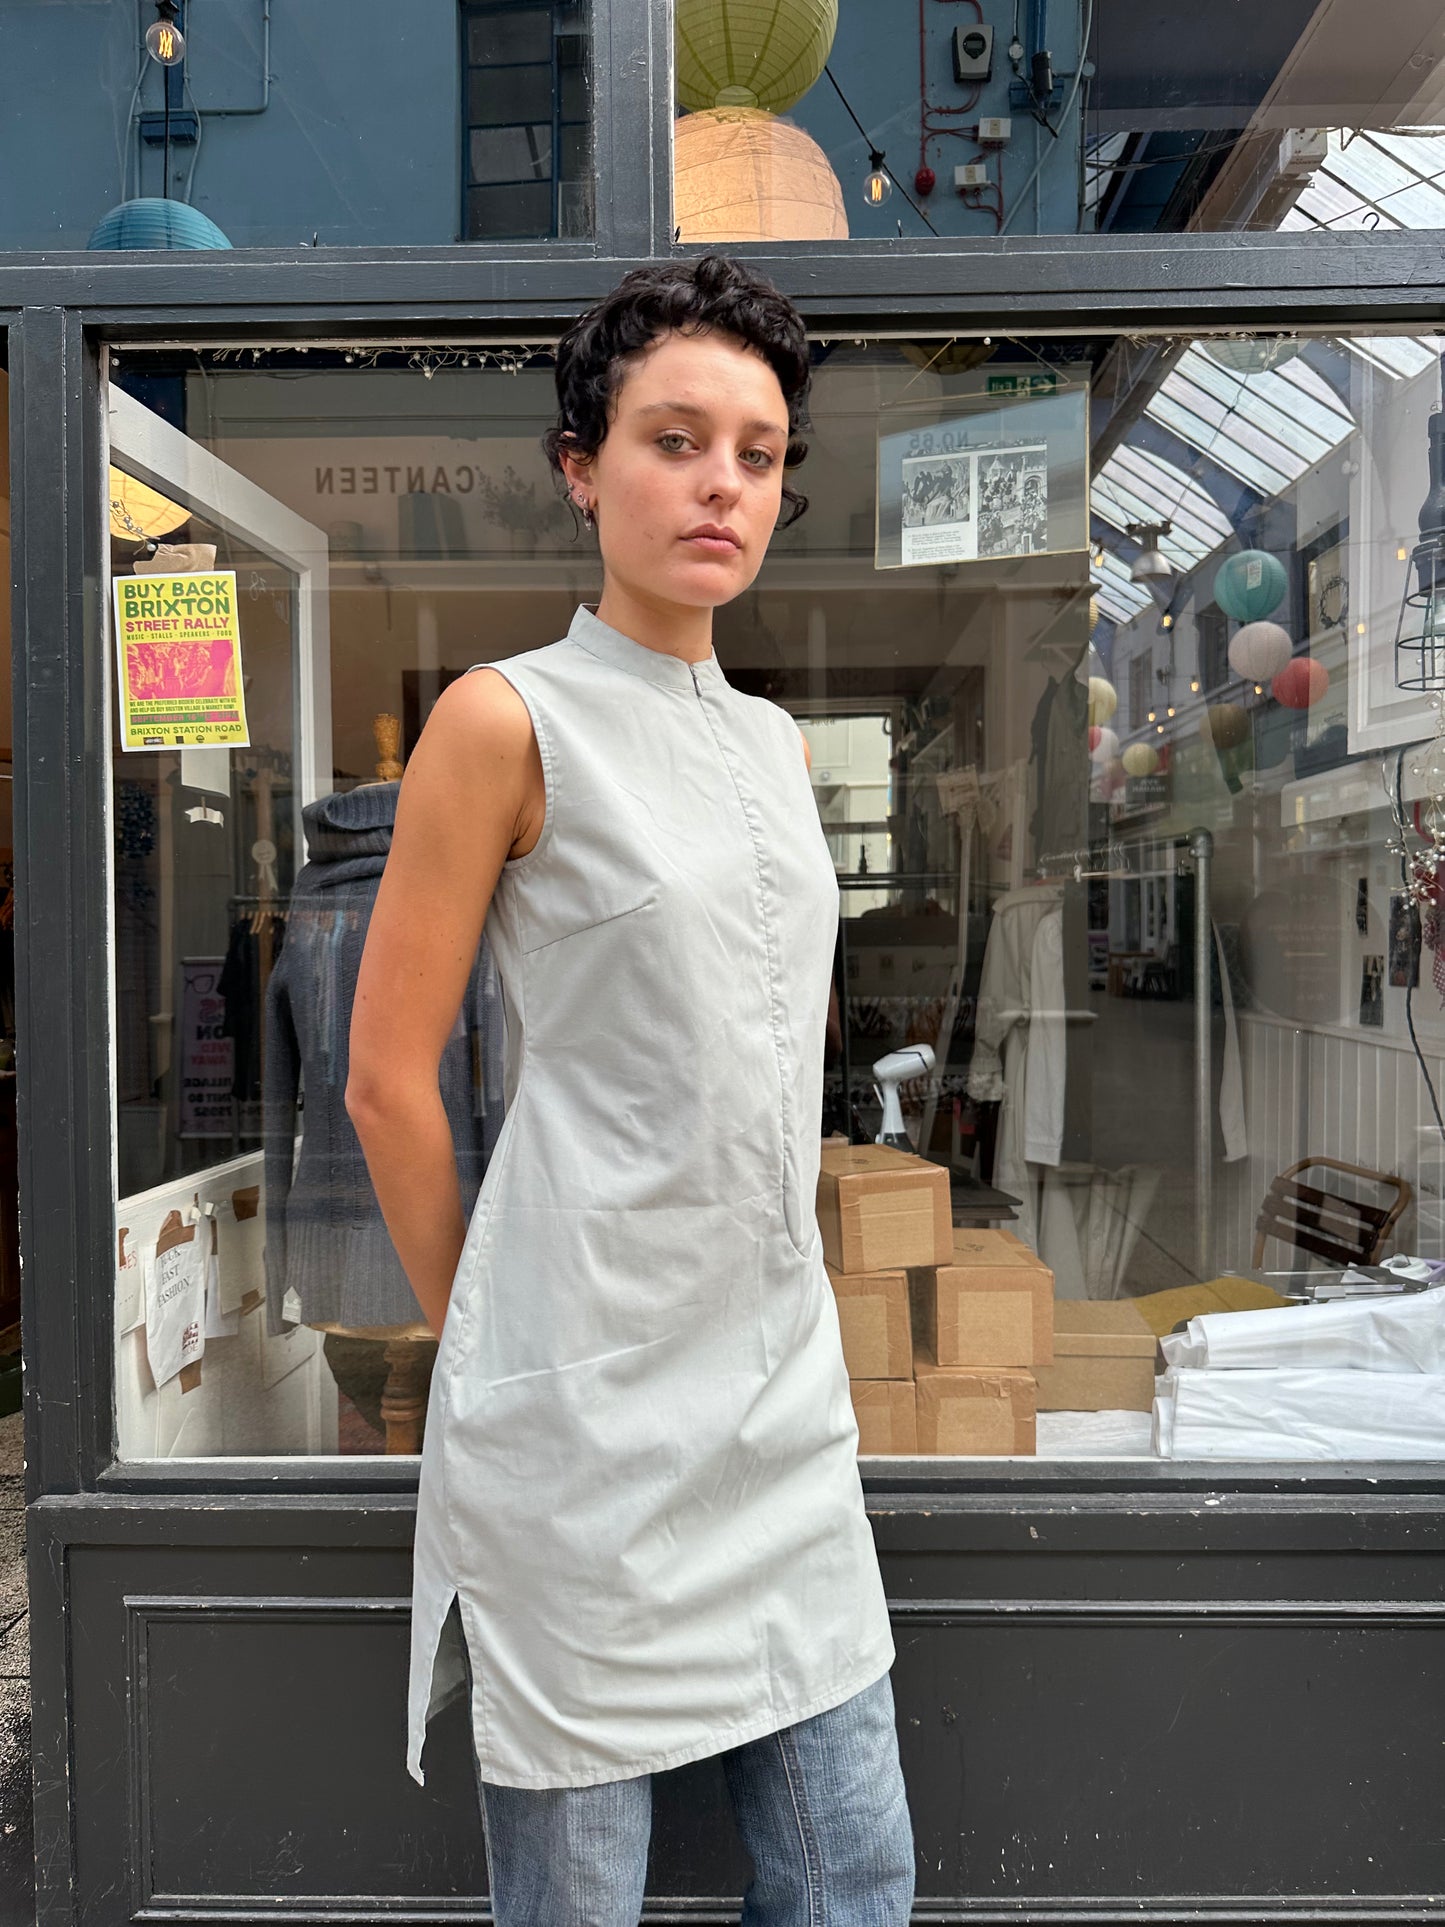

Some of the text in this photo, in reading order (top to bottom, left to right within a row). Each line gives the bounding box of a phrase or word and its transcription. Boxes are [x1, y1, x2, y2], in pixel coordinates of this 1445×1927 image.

[124, 580, 228, 599] BUY BACK
[126, 597, 230, 618] BRIXTON
[126, 617, 229, 632] STREET RALLY
[132, 714, 184, 722] SEPTEMBER
[131, 724, 242, 735] BRIXTON STATION ROAD
[162, 1263, 180, 1285] FAST
[158, 1275, 190, 1309] FASHION
